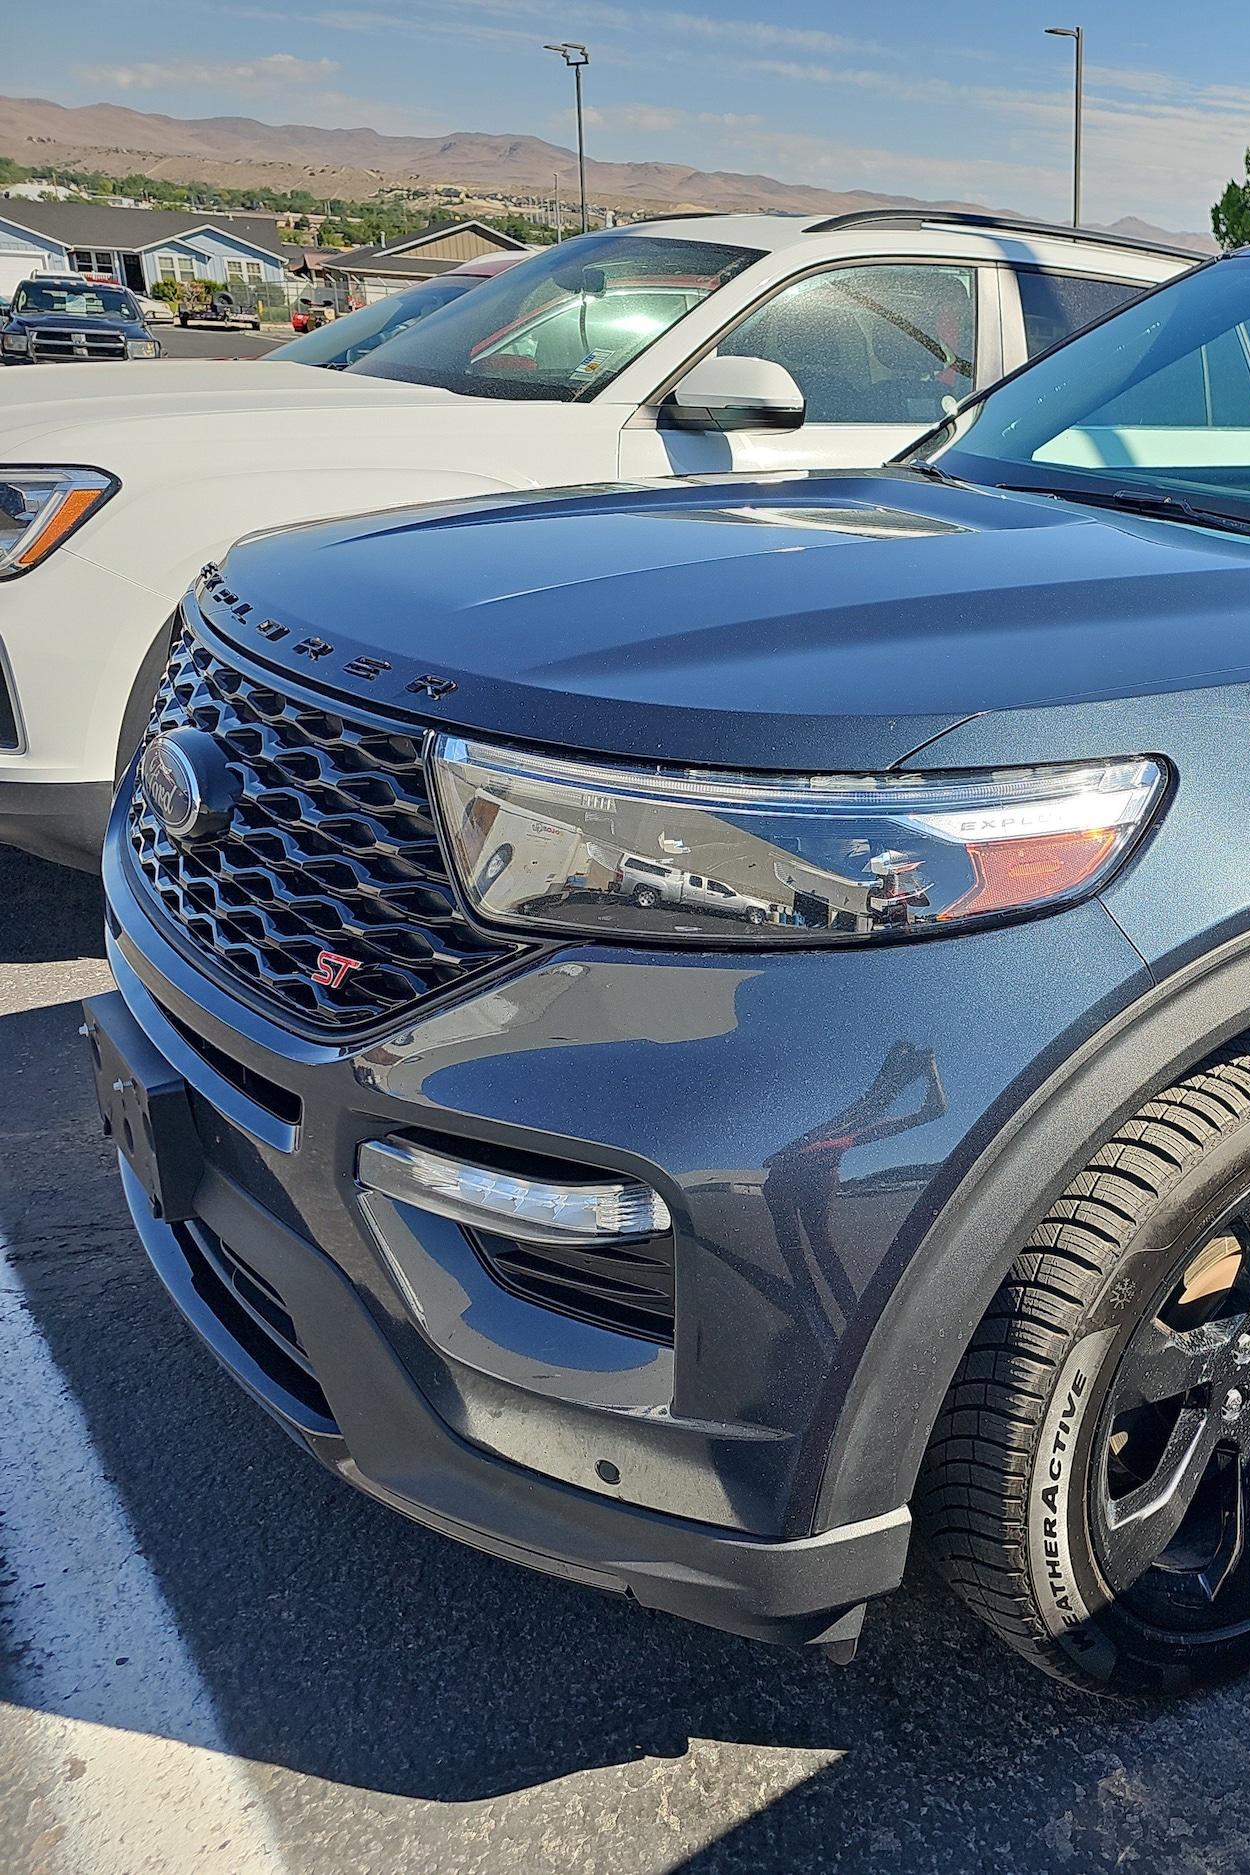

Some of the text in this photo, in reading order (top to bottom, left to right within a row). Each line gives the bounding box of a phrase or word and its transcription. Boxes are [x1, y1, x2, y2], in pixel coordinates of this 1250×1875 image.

[146, 755, 178, 815] Ford
[310, 950, 363, 989] ST
[1041, 1368, 1096, 1652] WEATHERACTIVE
